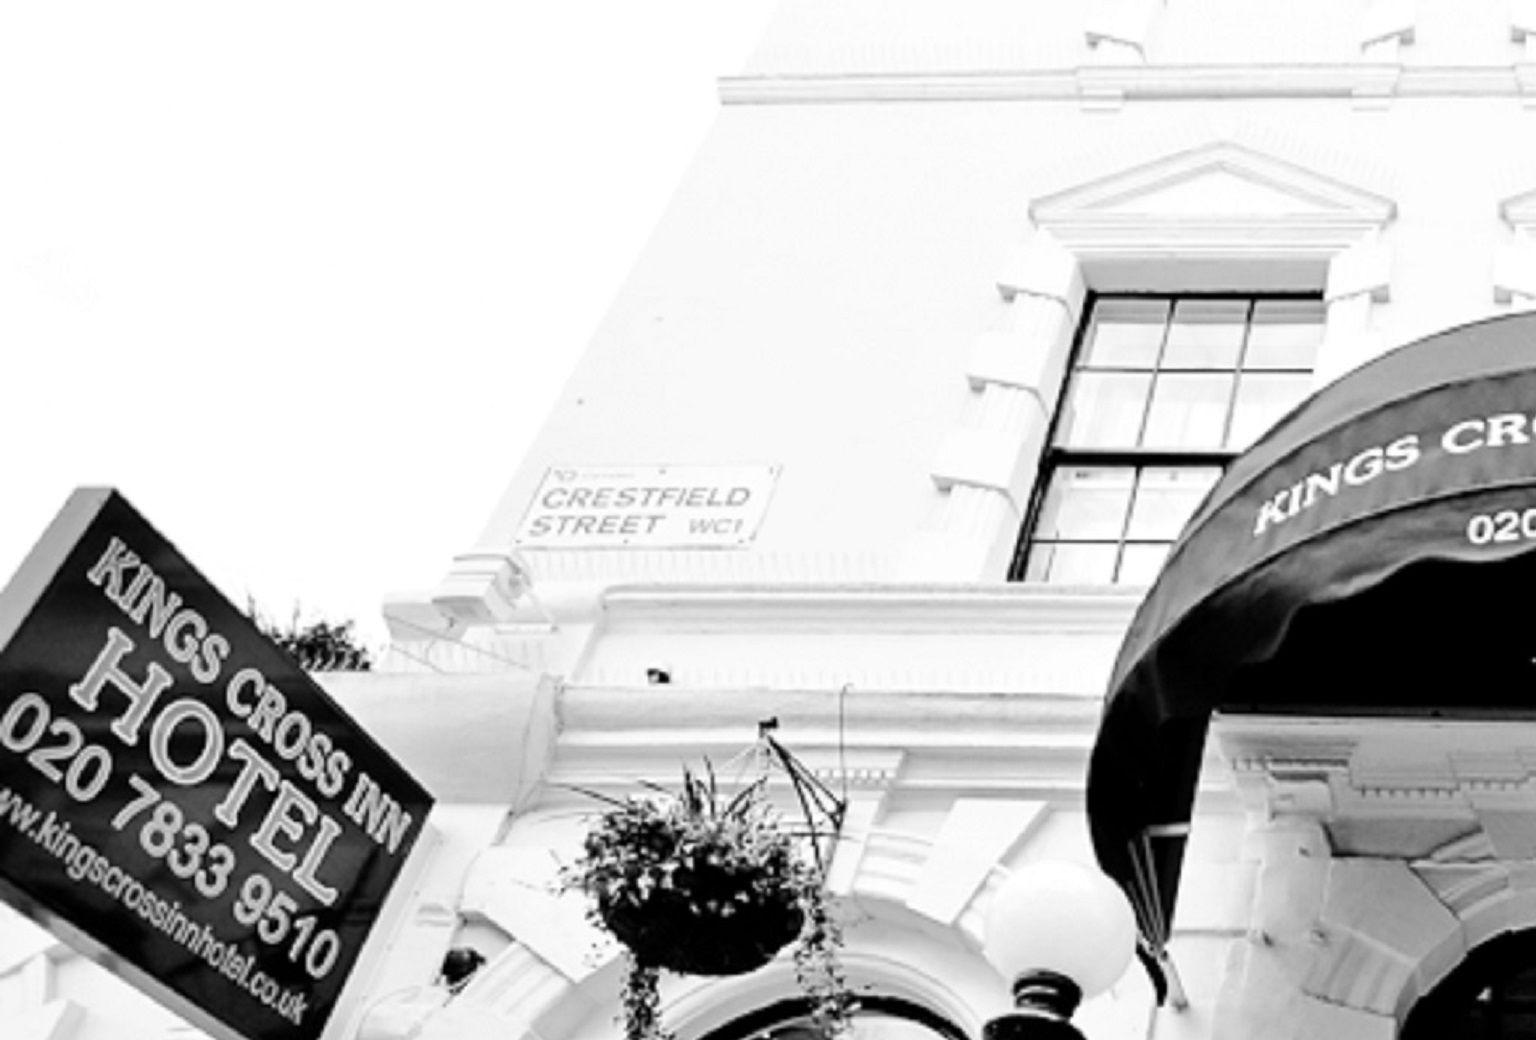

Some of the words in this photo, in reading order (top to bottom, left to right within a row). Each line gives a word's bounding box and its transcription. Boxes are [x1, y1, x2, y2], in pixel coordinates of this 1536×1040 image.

[529, 514, 667, 537] STREET
[689, 518, 744, 534] WC1
[541, 486, 752, 509] CRESTFIELD
[1252, 434, 1420, 536] KINGS
[69, 627, 343, 907] HOTEL
[87, 537, 230, 684] KINGS
[227, 667, 350, 797] CROSS
[343, 772, 413, 854] INN
[1, 692, 112, 802] 020
[112, 774, 235, 898] 7833
[234, 873, 340, 979] 9510
